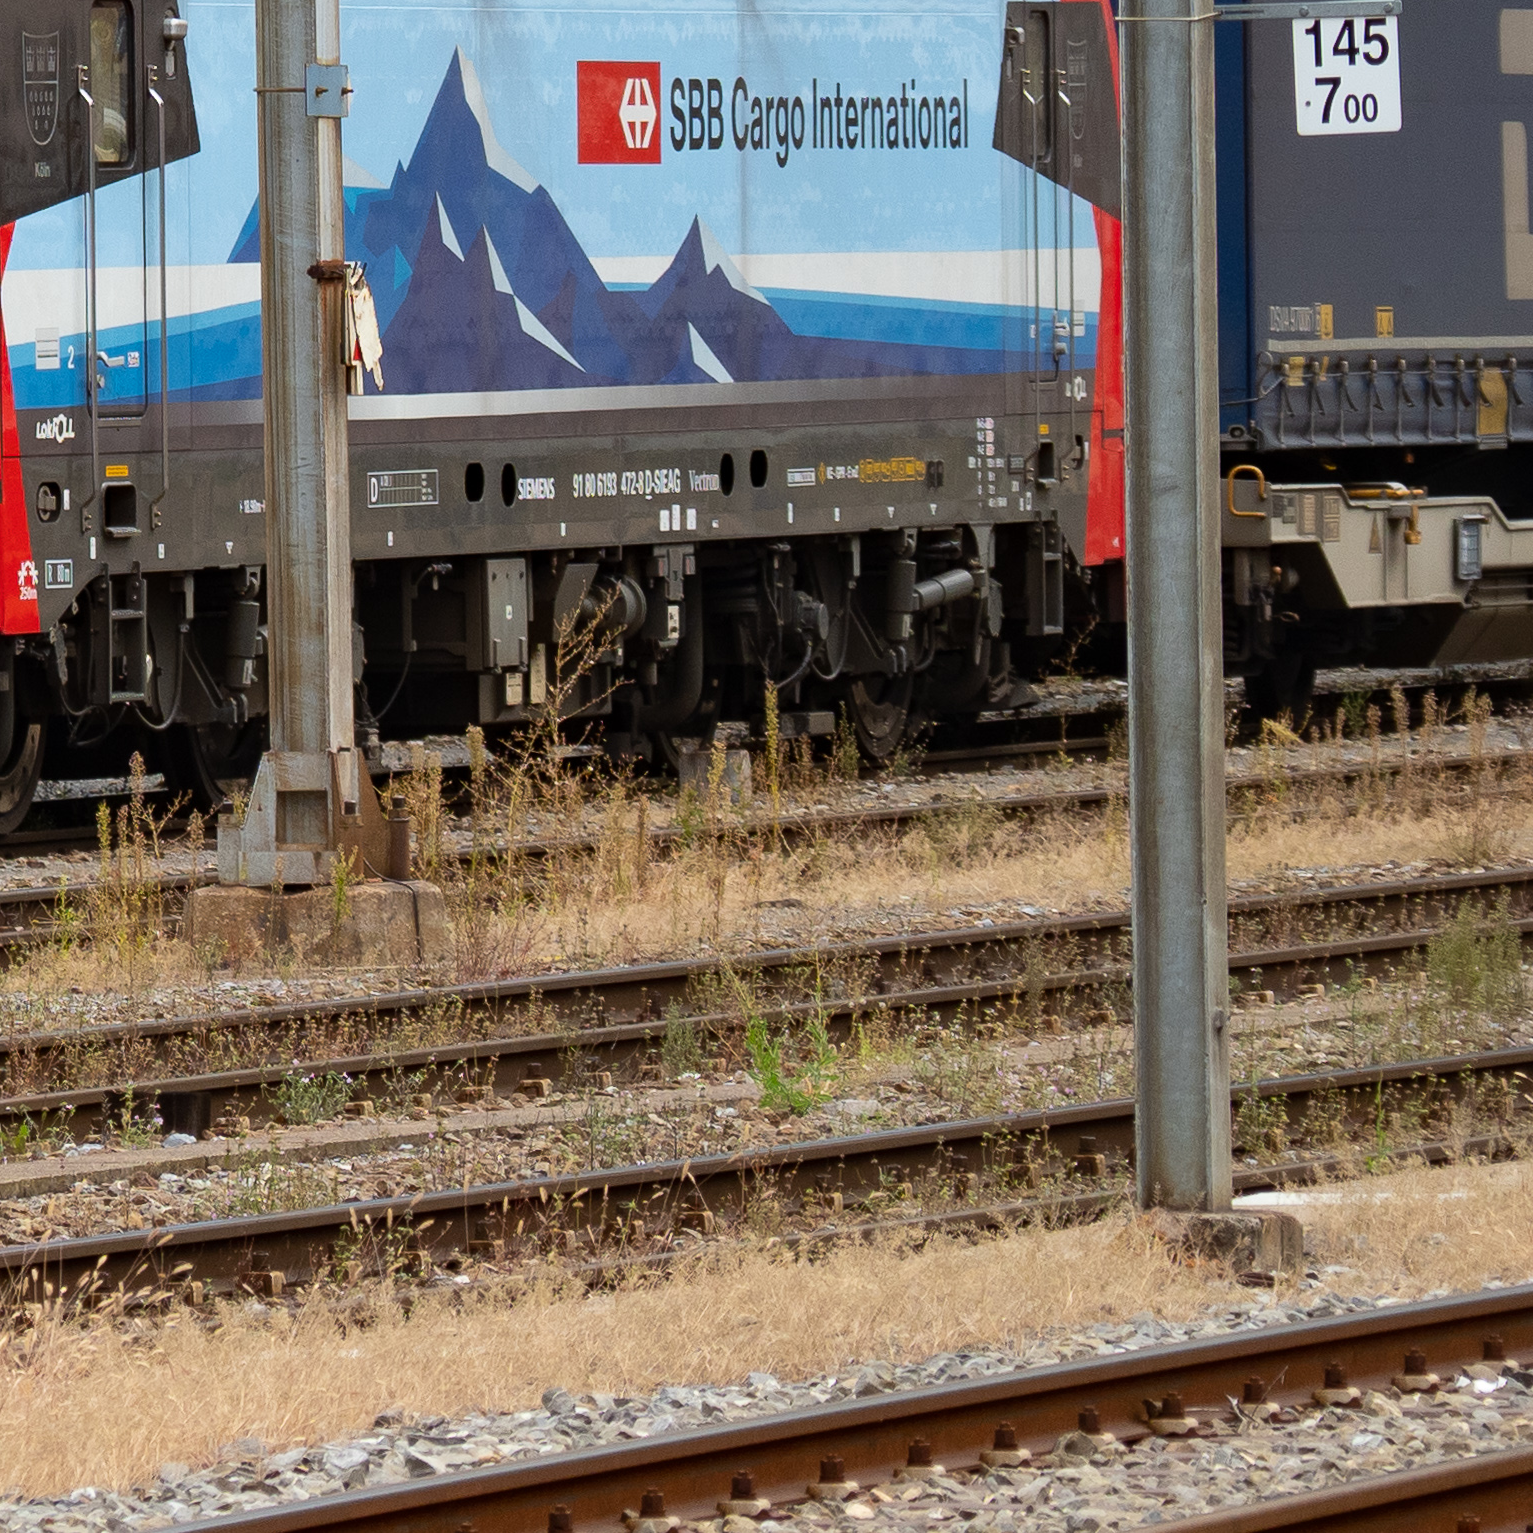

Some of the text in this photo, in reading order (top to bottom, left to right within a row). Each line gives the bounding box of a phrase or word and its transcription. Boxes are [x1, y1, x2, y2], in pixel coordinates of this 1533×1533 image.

[1305, 17, 1389, 67] 145
[670, 76, 968, 168] SBB Cargo International
[67, 345, 75, 369] 2
[370, 477, 379, 503] D
[517, 478, 556, 499] SIEMENS
[573, 474, 584, 498] 91
[585, 473, 596, 497] 80
[597, 472, 617, 497] 6193
[645, 468, 681, 500] D-SIEAG
